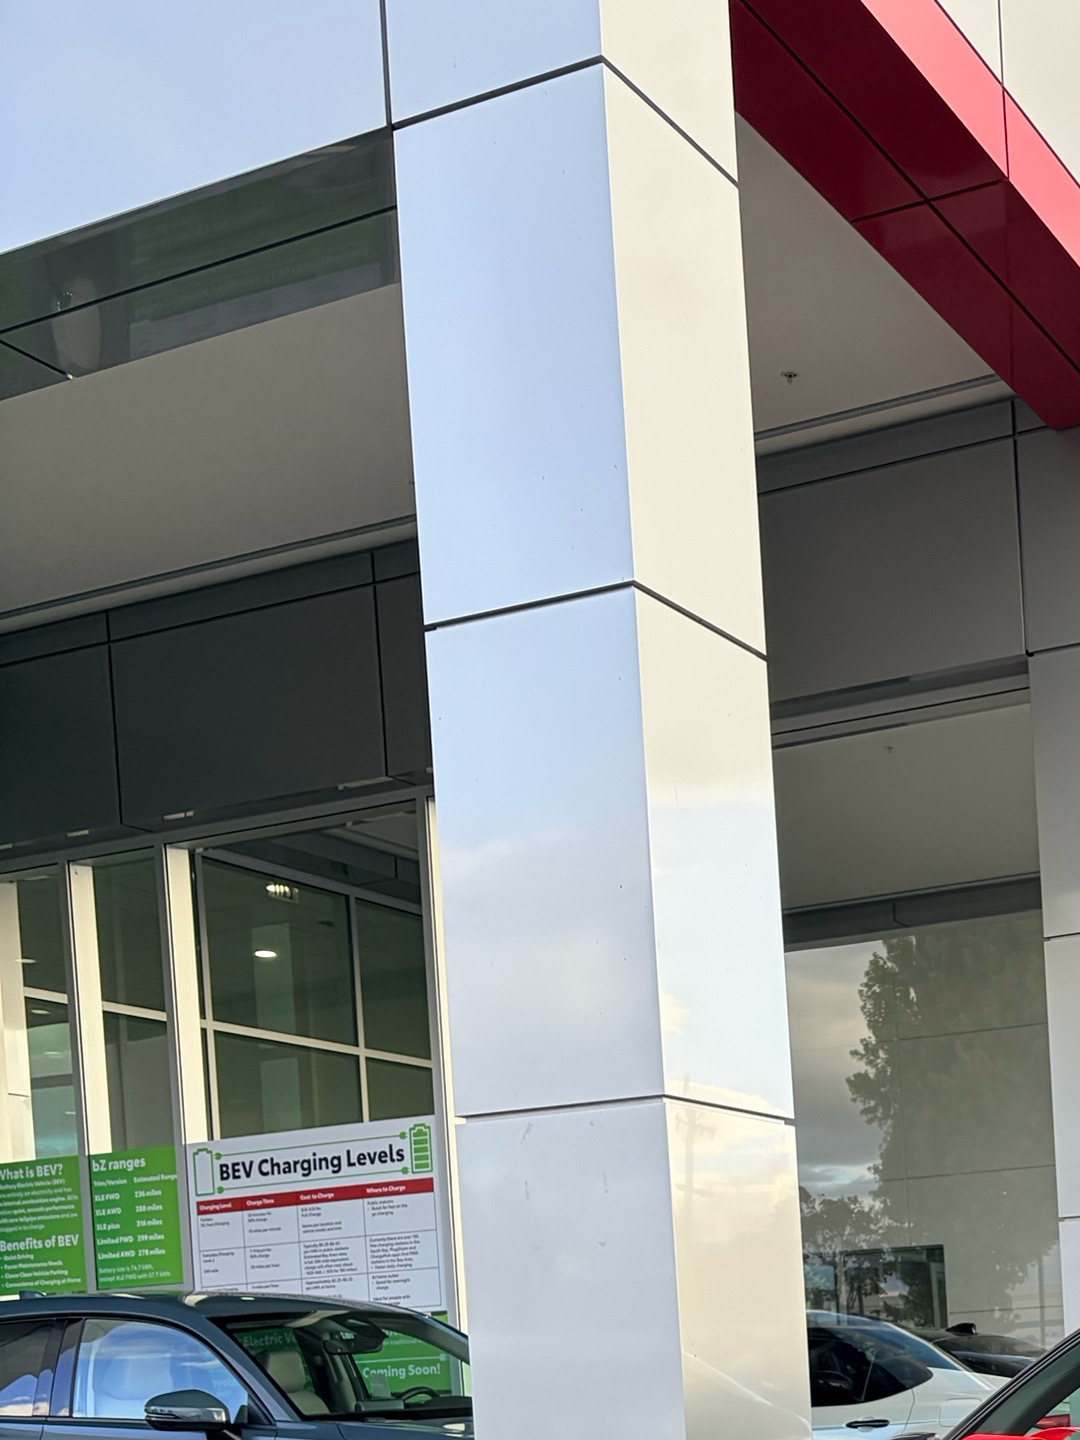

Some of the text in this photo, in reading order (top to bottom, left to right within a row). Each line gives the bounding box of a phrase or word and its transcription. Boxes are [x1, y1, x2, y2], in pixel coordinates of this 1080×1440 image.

[92, 1158, 146, 1172] bZ ranges
[219, 1144, 405, 1181] BEV Charging Levels
[25, 1166, 35, 1178] is
[36, 1163, 63, 1177] BEV?
[0, 1234, 79, 1252] Benefits of BEV
[408, 1363, 441, 1376] Soon!
